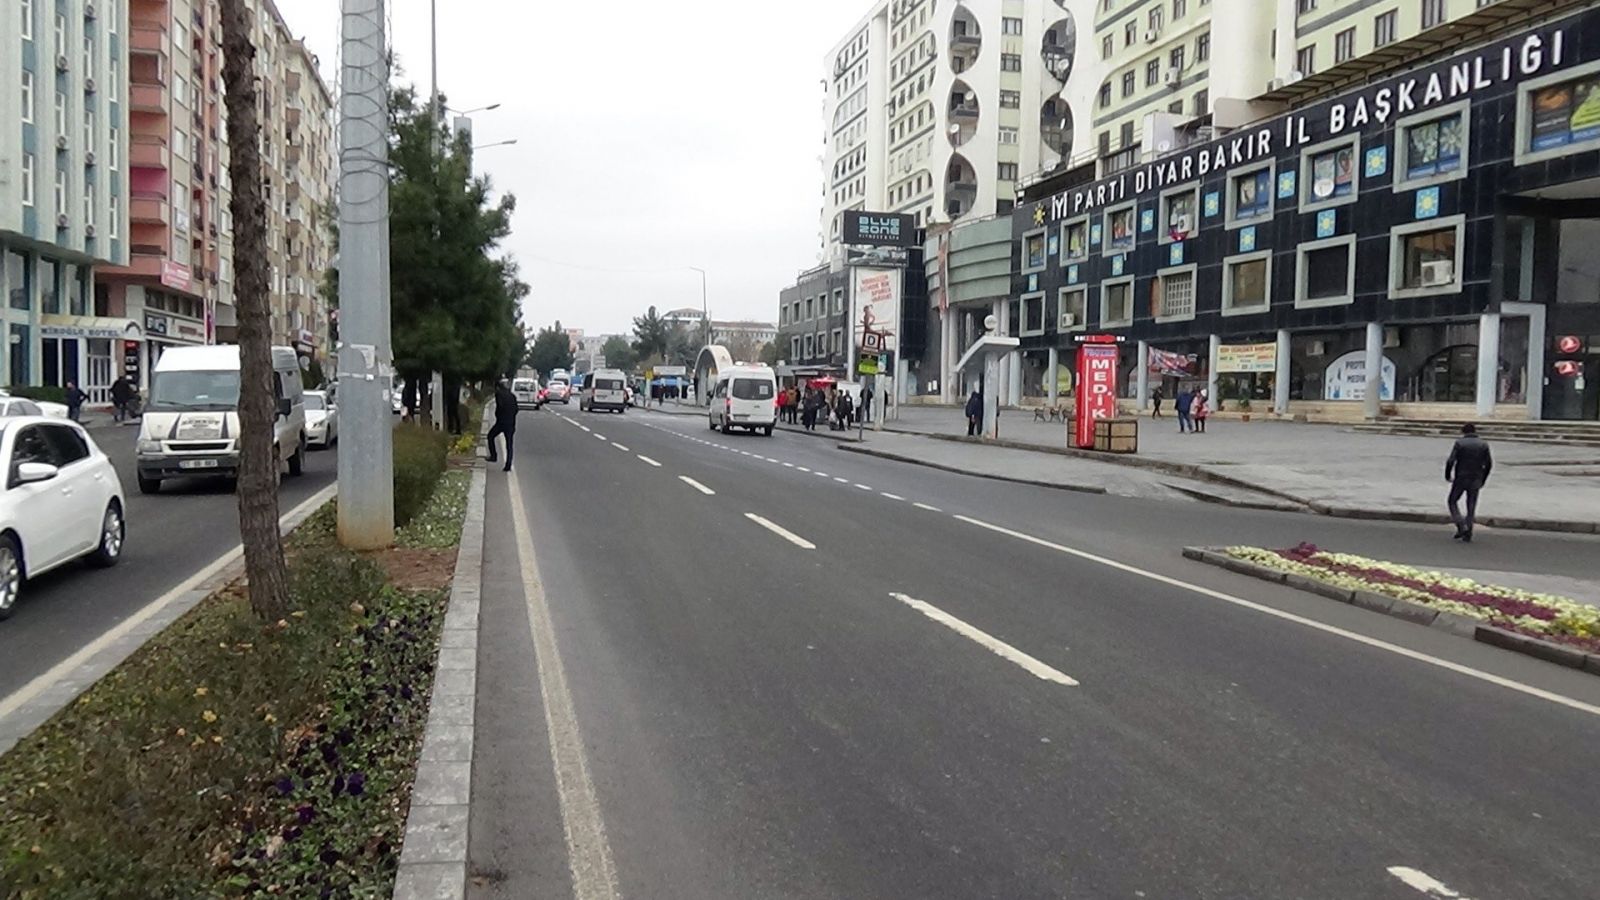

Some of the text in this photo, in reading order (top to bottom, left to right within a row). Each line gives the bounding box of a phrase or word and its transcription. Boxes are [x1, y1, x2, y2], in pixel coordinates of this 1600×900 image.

[1051, 191, 1068, 221] İYİ
[1074, 177, 1125, 213] PARTİ
[1135, 129, 1272, 194] DİYARBAKIR
[1285, 115, 1311, 147] İL
[1330, 30, 1563, 134] BAŞKANLIĞI
[859, 215, 900, 226] BLUE
[859, 225, 900, 235] ZONE
[867, 335, 876, 346] D
